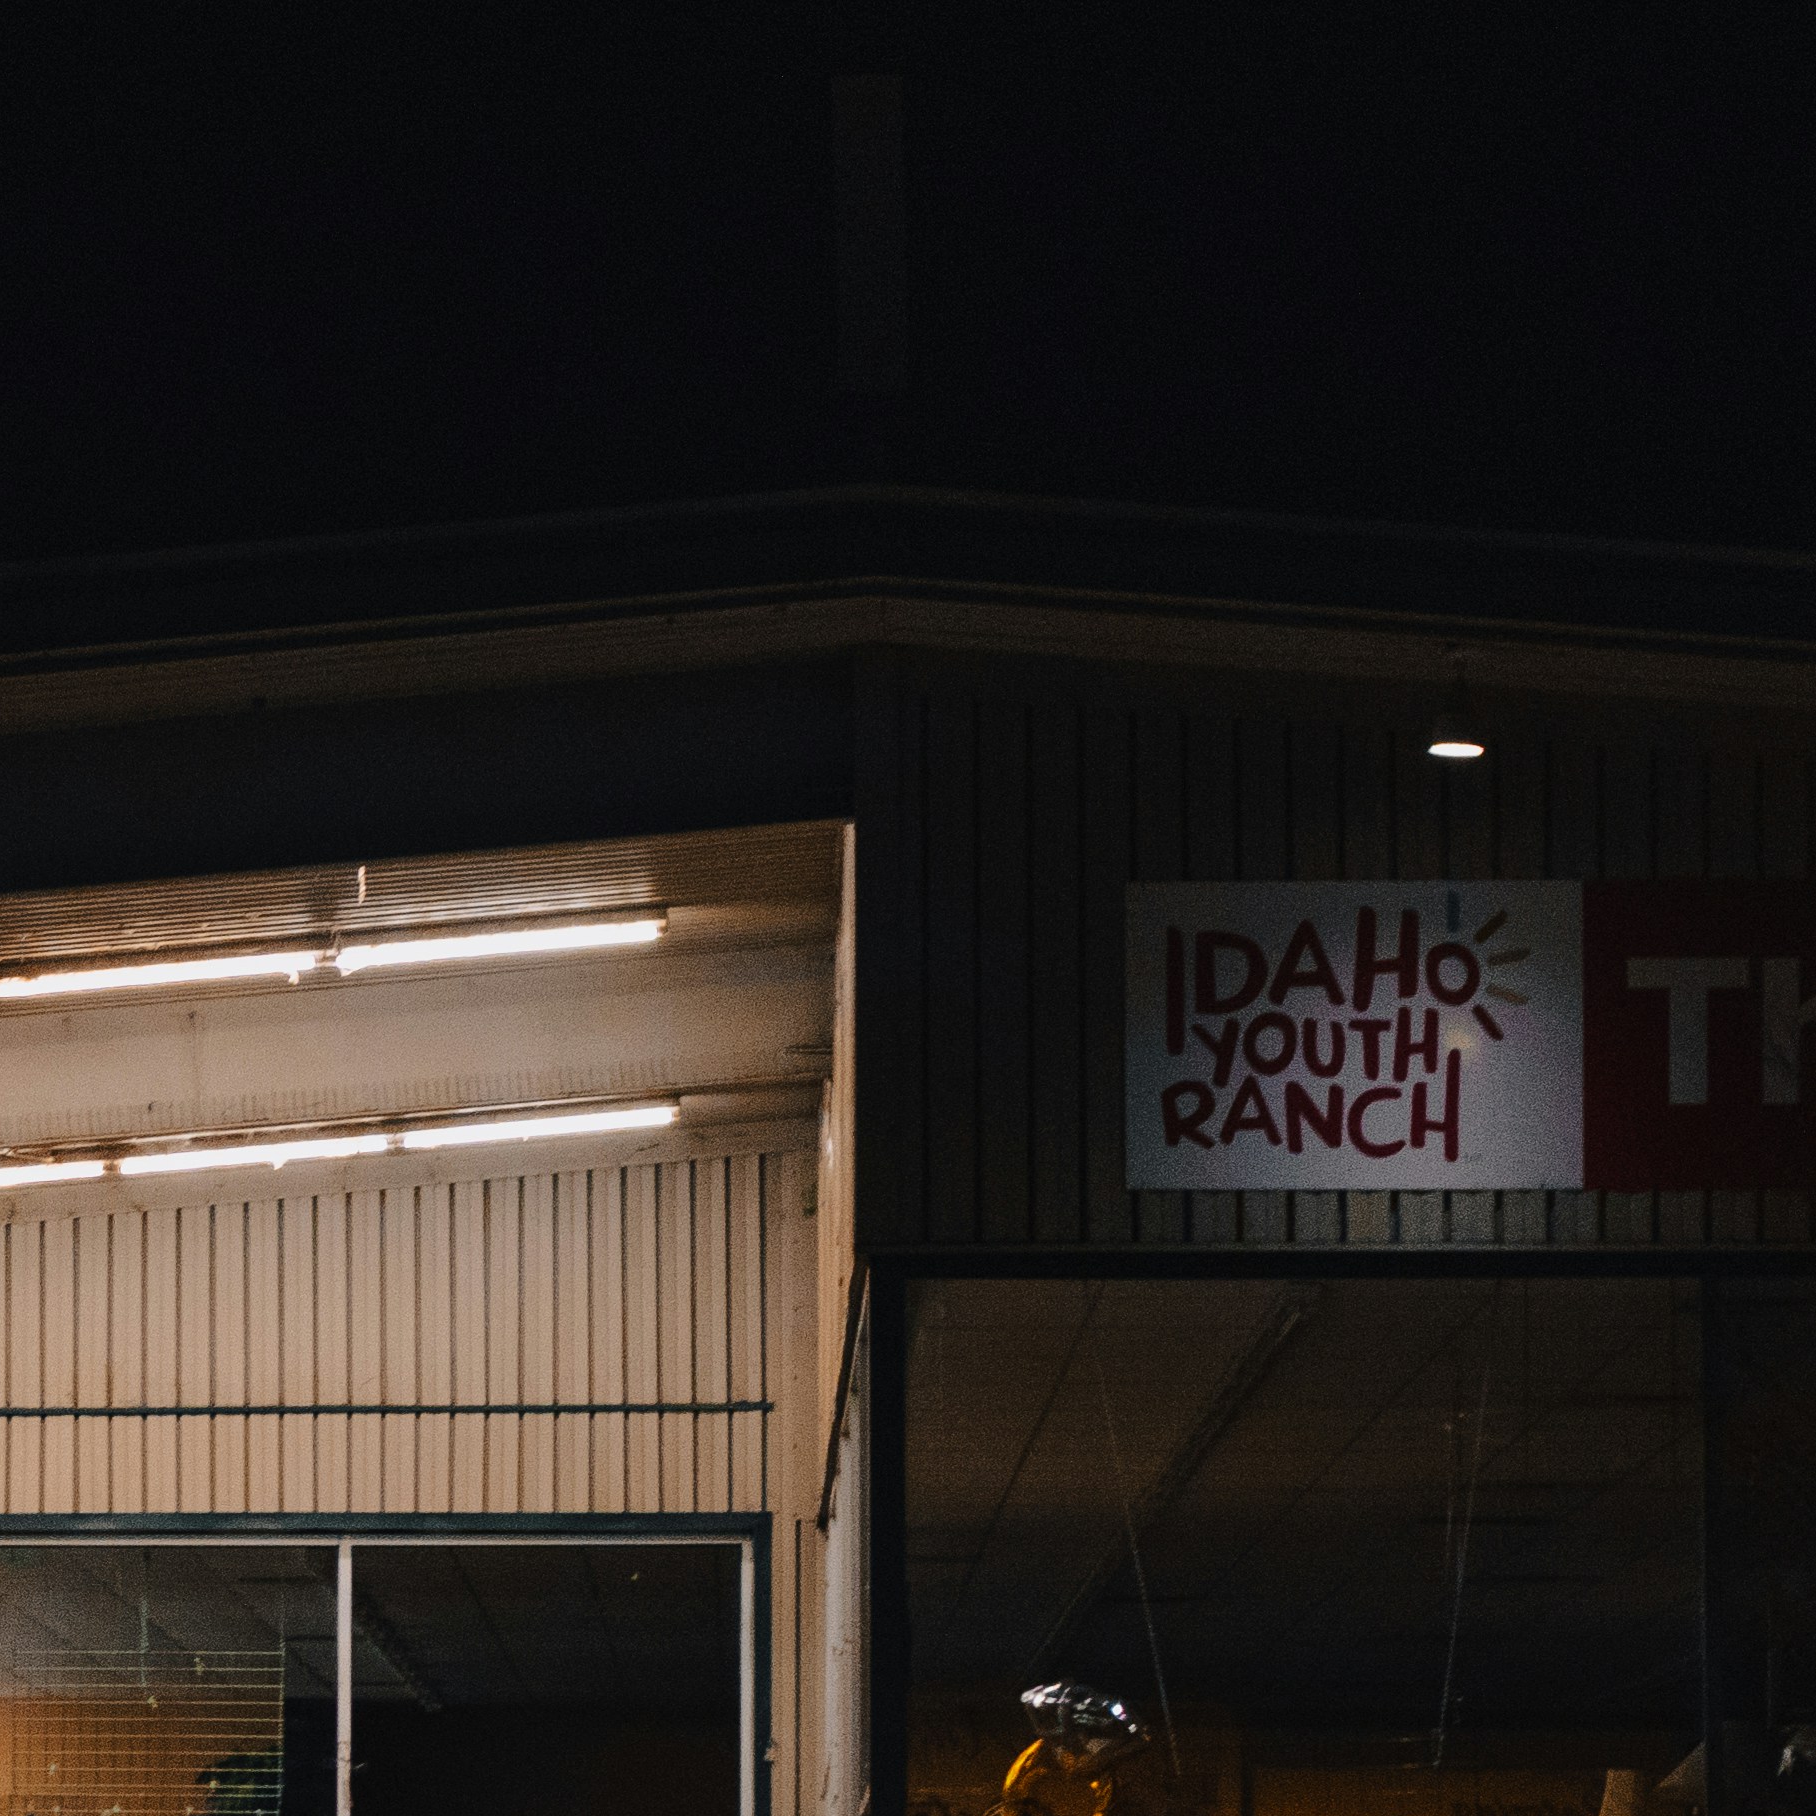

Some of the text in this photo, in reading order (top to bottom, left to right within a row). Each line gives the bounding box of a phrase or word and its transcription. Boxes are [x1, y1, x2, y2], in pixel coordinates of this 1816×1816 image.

[1166, 905, 1481, 1056] IDAHO
[1192, 1005, 1440, 1088] YOUTH
[1161, 1047, 1461, 1163] RANCH
